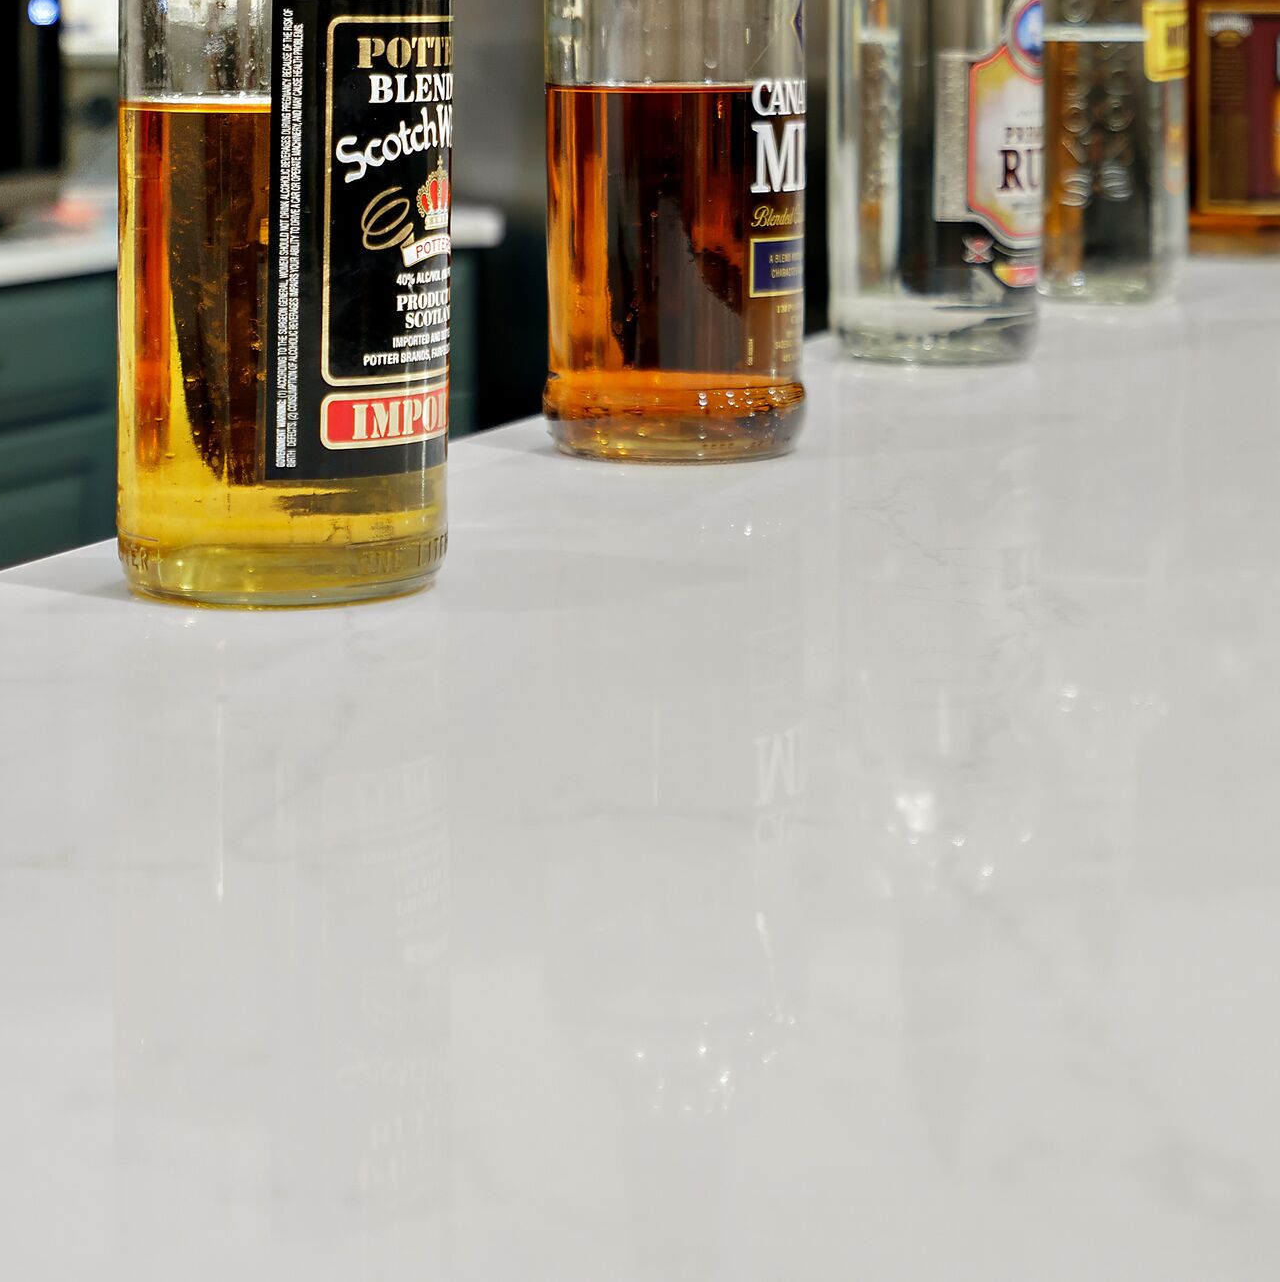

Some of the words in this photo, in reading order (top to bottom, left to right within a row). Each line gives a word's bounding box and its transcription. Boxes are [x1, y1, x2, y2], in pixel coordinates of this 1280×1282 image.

[283, 18, 293, 30] RISK
[283, 32, 293, 42] THE
[293, 24, 304, 55] PROBLEMS.
[282, 53, 293, 77] BECAUSE
[293, 56, 303, 76] HEALTH
[282, 79, 292, 111] PREGNANCY
[292, 77, 303, 96] CAUSE
[368, 73, 454, 104] BLEND
[292, 97, 303, 109] MAY
[281, 114, 292, 135] DURING
[292, 110, 302, 122] AND
[292, 123, 302, 156] MACHINERY,
[336, 106, 439, 184] Scotch
[436, 104, 453, 149] W
[281, 136, 291, 167] BEVERAGES
[291, 157, 302, 181] OPERATE
[280, 169, 291, 200] ALCOHOLIC
[291, 182, 301, 190] OR
[291, 192, 301, 203] CAR
[280, 201, 290, 218] DRINK
[290, 209, 301, 225] DRIVE
[751, 205, 793, 228] Blended
[280, 220, 290, 231] NOT
[290, 226, 301, 234] TO
[279, 233, 290, 255] SHOULD
[290, 235, 300, 256] ABILITY
[279, 257, 289, 278] WOMEN
[290, 257, 300, 272] YOUR
[289, 274, 300, 297] IMPAIRS
[396, 273, 415, 286] 40%
[278, 307, 288, 334] SURGEON
[289, 298, 299, 330] BEVERAGES
[278, 336, 288, 347] THE
[278, 347, 288, 355] TO
[288, 331, 299, 361] ALCOHOLIC
[392, 333, 430, 348] IMPORTED
[288, 362, 299, 370] OF
[363, 351, 399, 367] POTTER
[277, 356, 288, 389] ACCORDING
[288, 371, 298, 411] CONSUMPTION
[276, 429, 286, 467] GOVERNMENT
[287, 451, 297, 467] BIRTH
